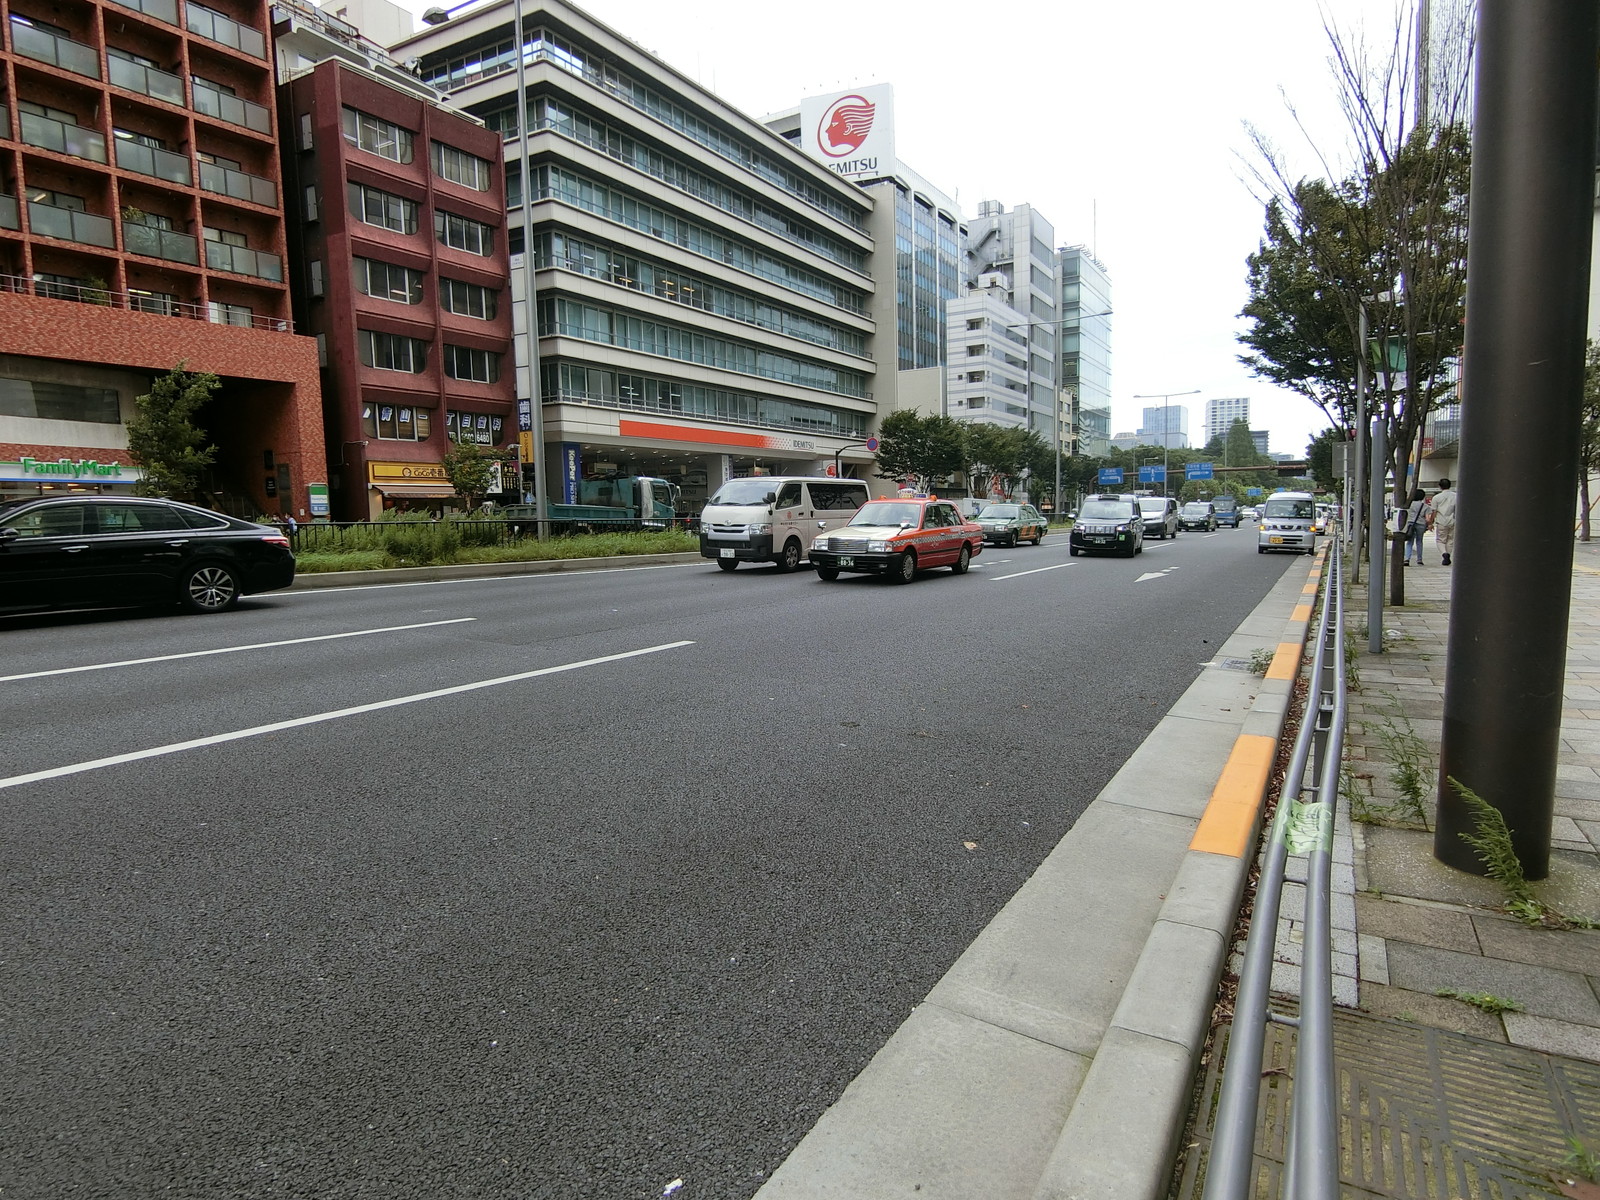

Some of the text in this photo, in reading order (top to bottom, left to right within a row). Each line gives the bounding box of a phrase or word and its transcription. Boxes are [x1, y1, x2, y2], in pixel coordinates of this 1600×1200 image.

[519, 401, 531, 427] 歯科
[792, 439, 815, 449] IDEMITSU
[22, 458, 122, 478] FamilyMart
